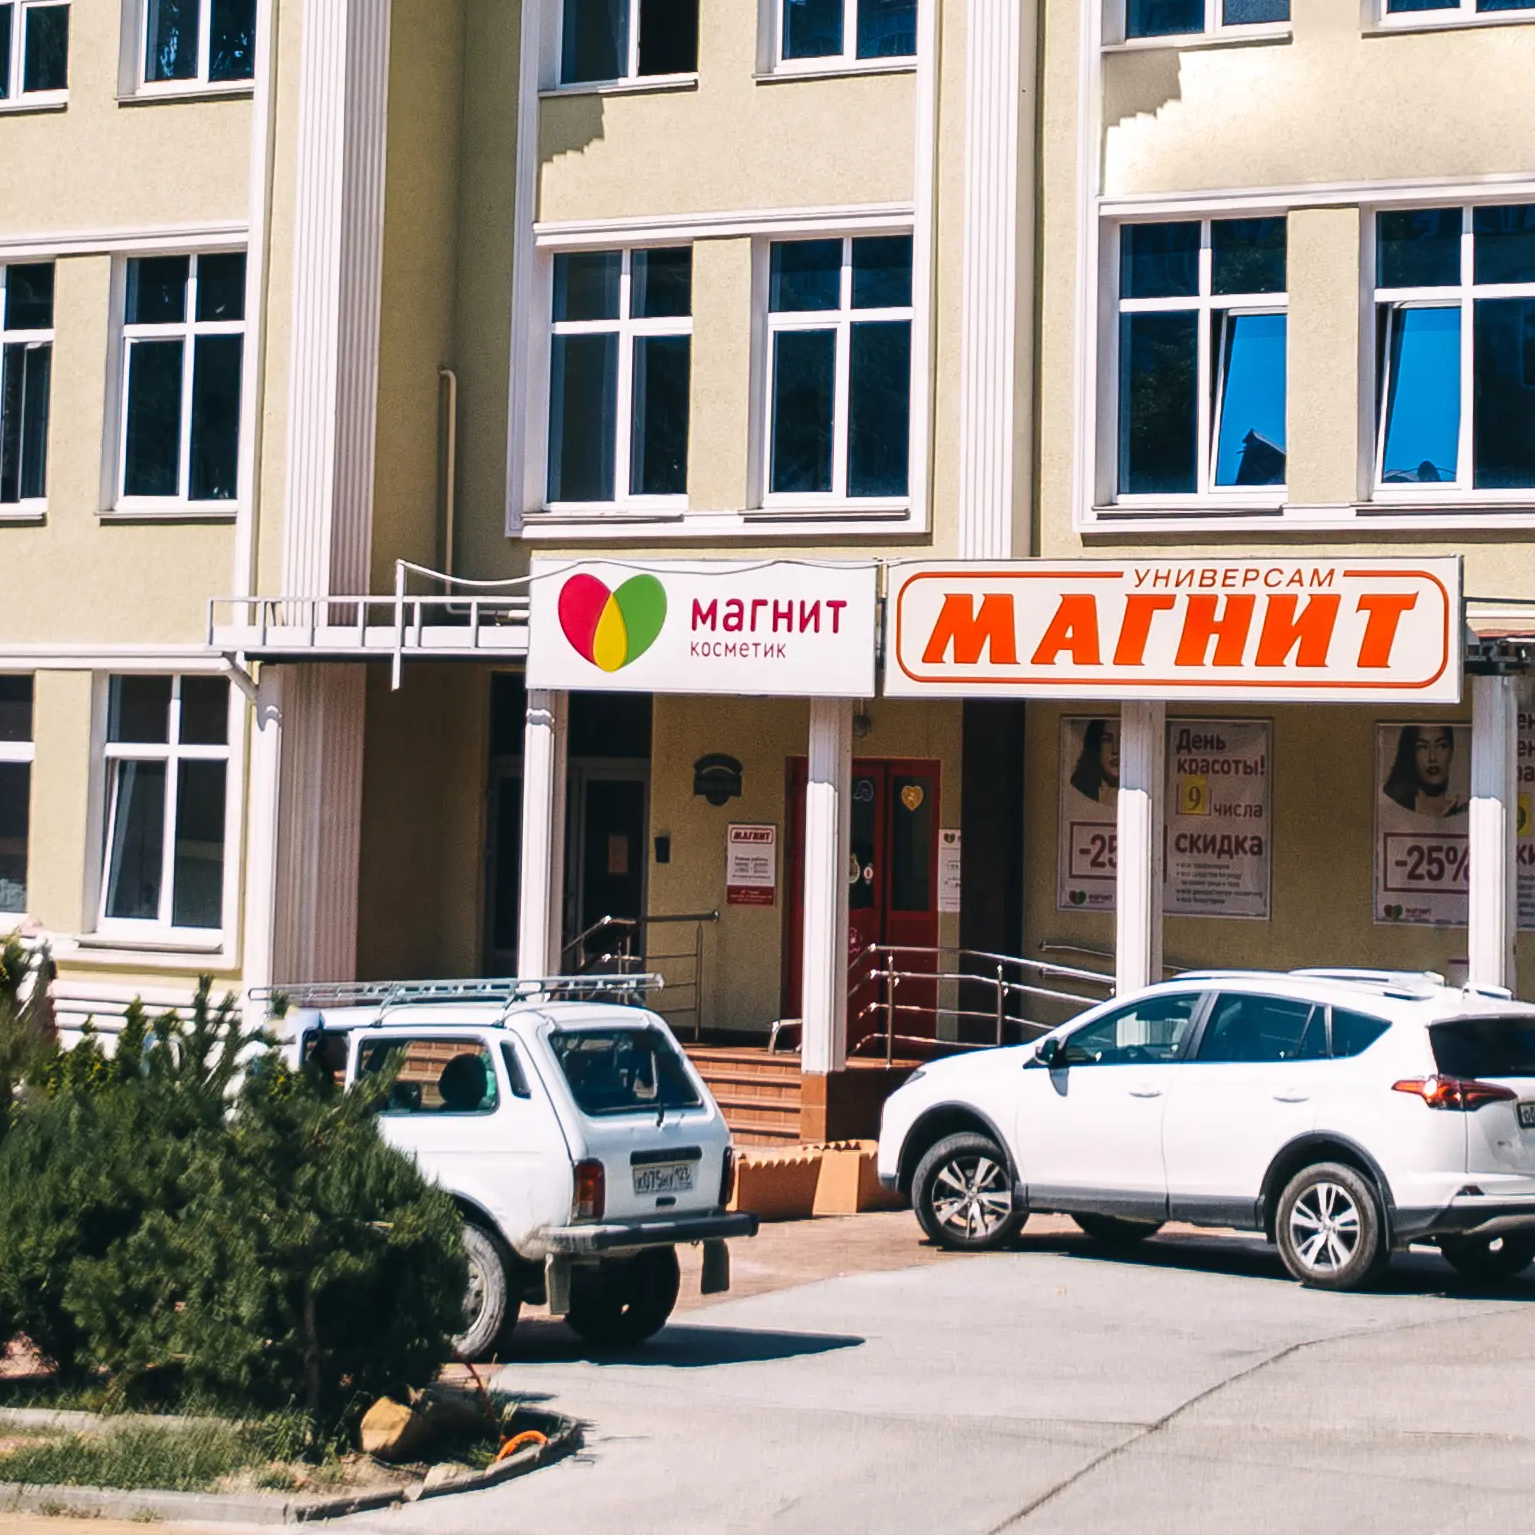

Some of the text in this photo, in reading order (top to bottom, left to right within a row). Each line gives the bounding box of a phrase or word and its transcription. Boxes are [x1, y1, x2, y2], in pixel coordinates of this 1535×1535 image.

[1134, 568, 1335, 588] УНИВЕРСАМ
[690, 598, 848, 634] магнит
[922, 591, 1419, 668] МАГНИТ
[690, 640, 786, 659] косметик
[1175, 728, 1226, 754] День
[1176, 754, 1266, 775] красоты!
[1188, 785, 1263, 818] 9 числа
[1174, 832, 1264, 859] скидка
